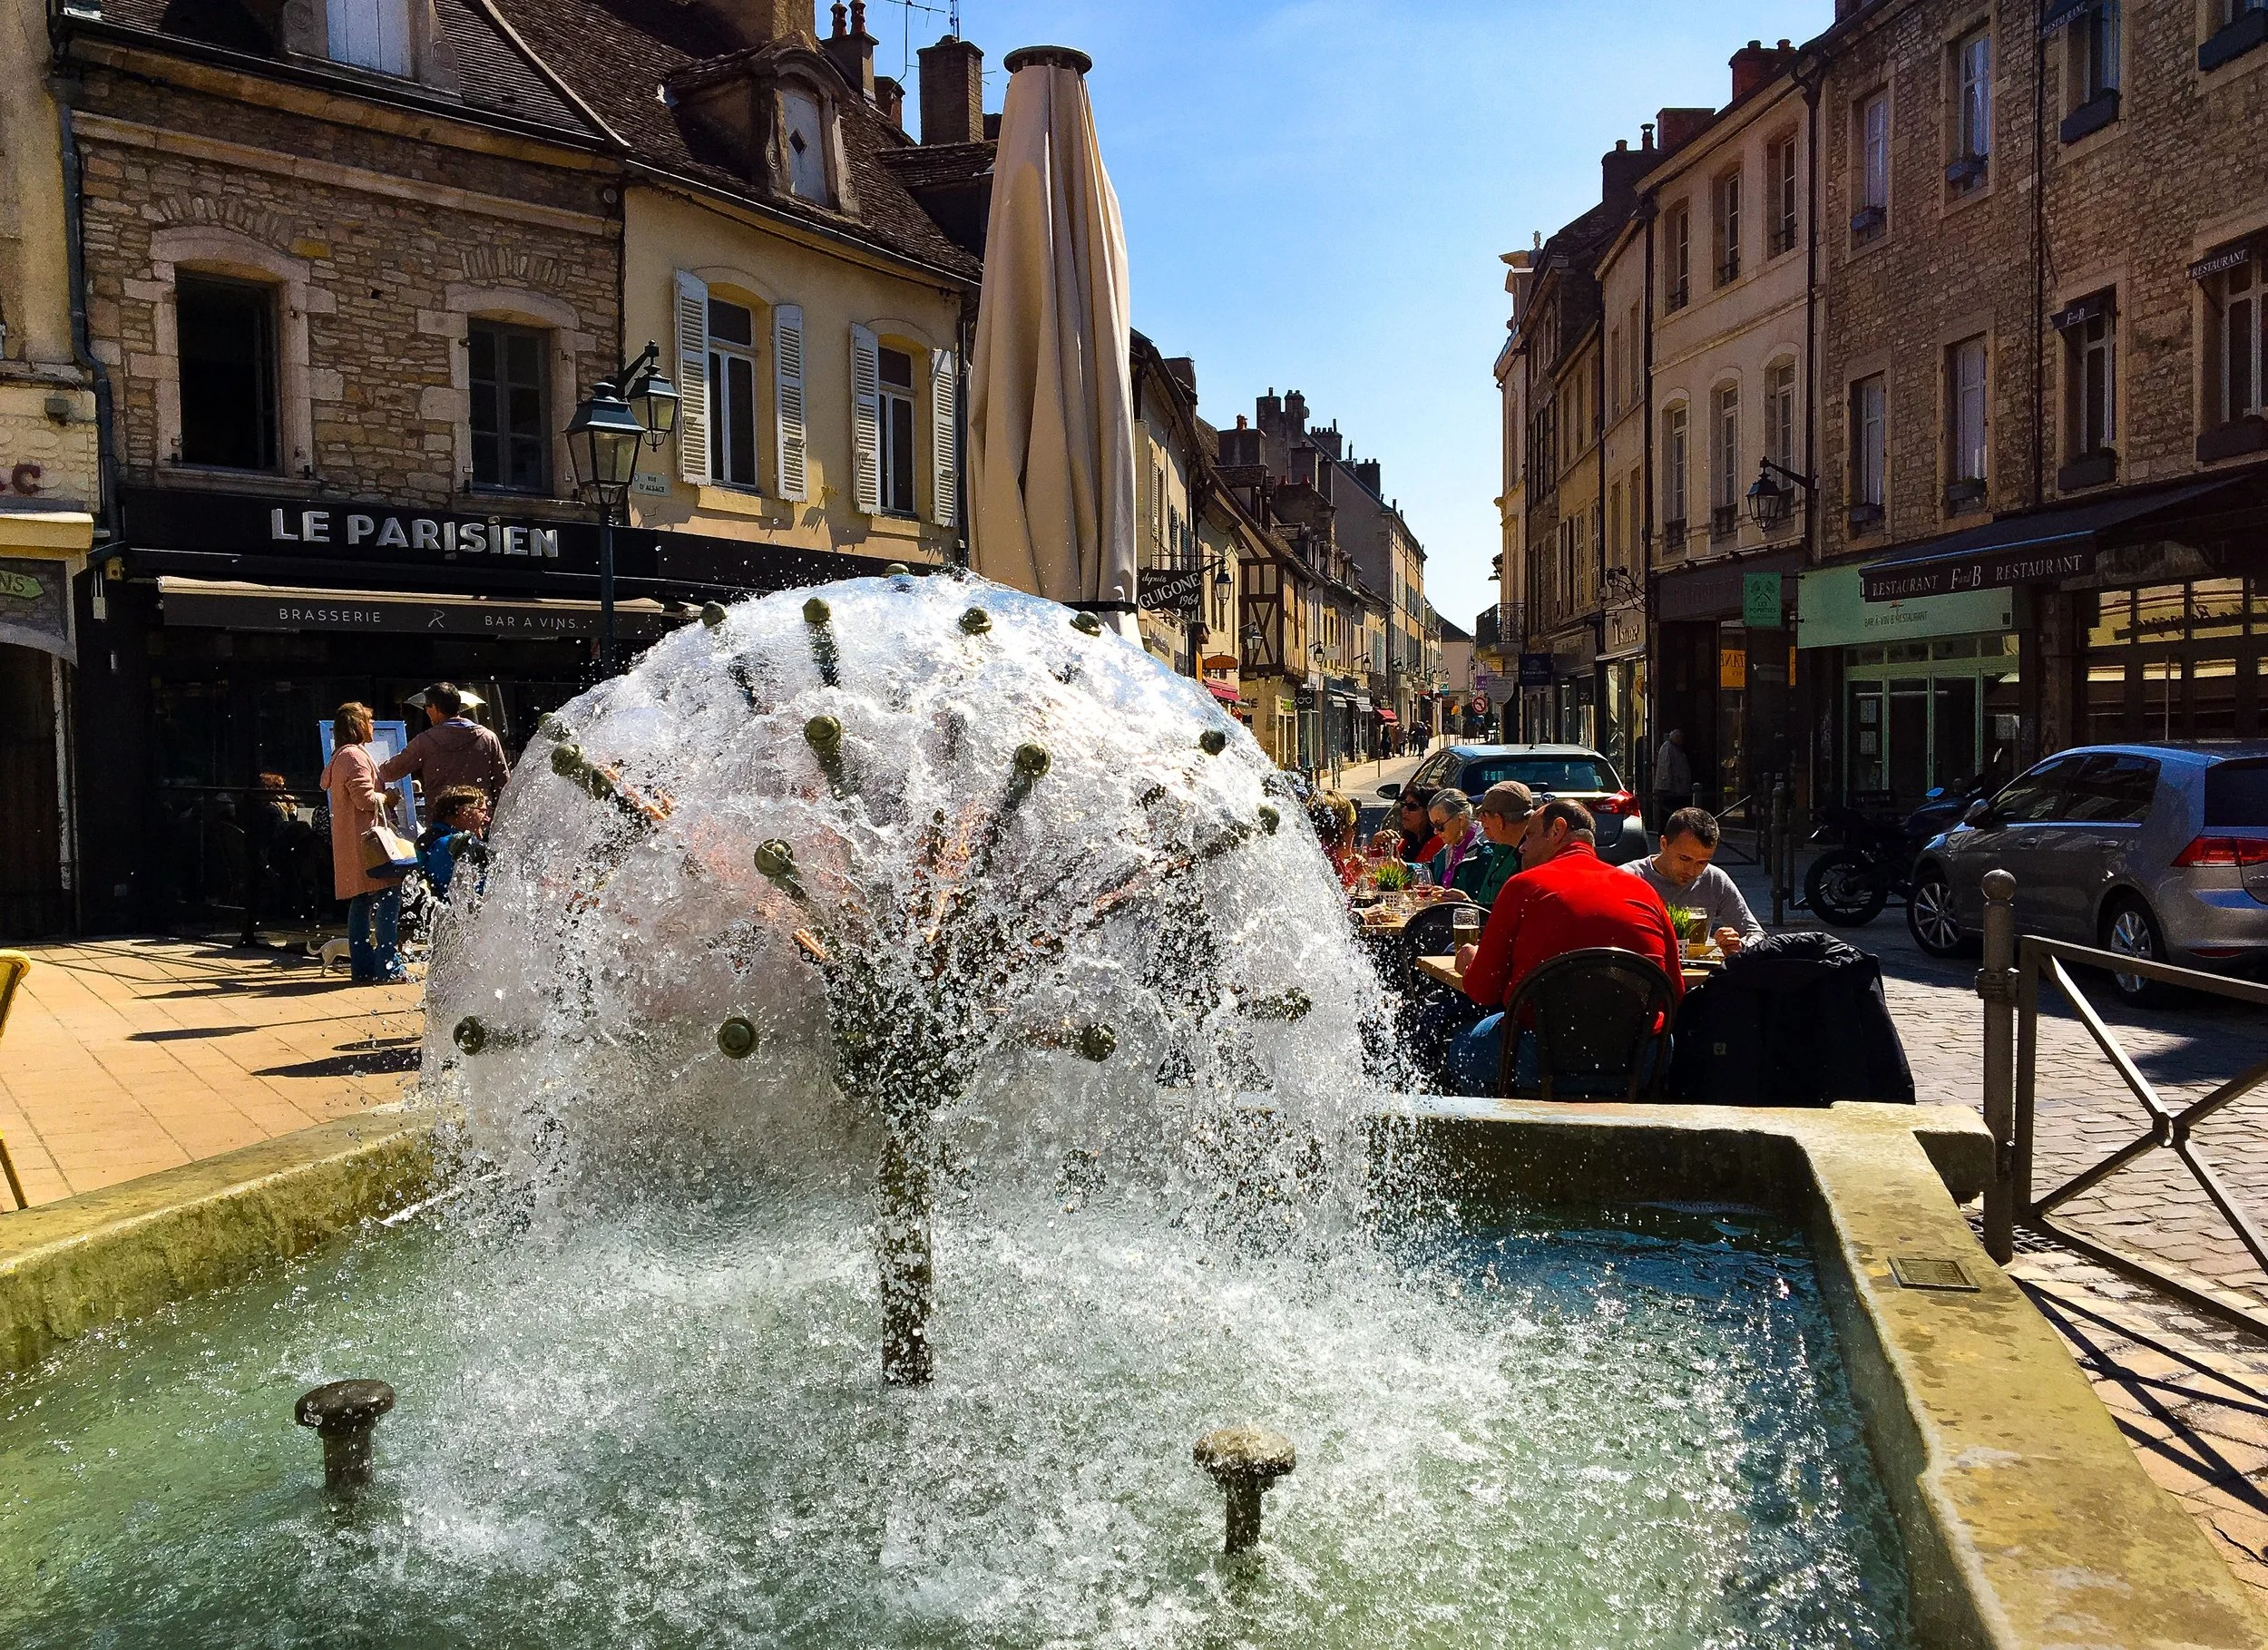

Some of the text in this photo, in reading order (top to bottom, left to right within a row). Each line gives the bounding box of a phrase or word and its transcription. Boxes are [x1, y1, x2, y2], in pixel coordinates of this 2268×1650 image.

[2192, 249, 2246, 278] RESTAURANT
[0, 464, 41, 494] C
[270, 508, 330, 542] LE
[1141, 572, 1168, 586] depuis
[1872, 575, 1939, 598] RESTAURANT
[1996, 553, 2083, 581] RESTAURANT
[1139, 572, 1201, 609] GUIGONE
[1178, 593, 1199, 607] 1964
[279, 609, 381, 623] BRASSERIE
[484, 615, 515, 627] BAR
[523, 617, 533, 628] A
